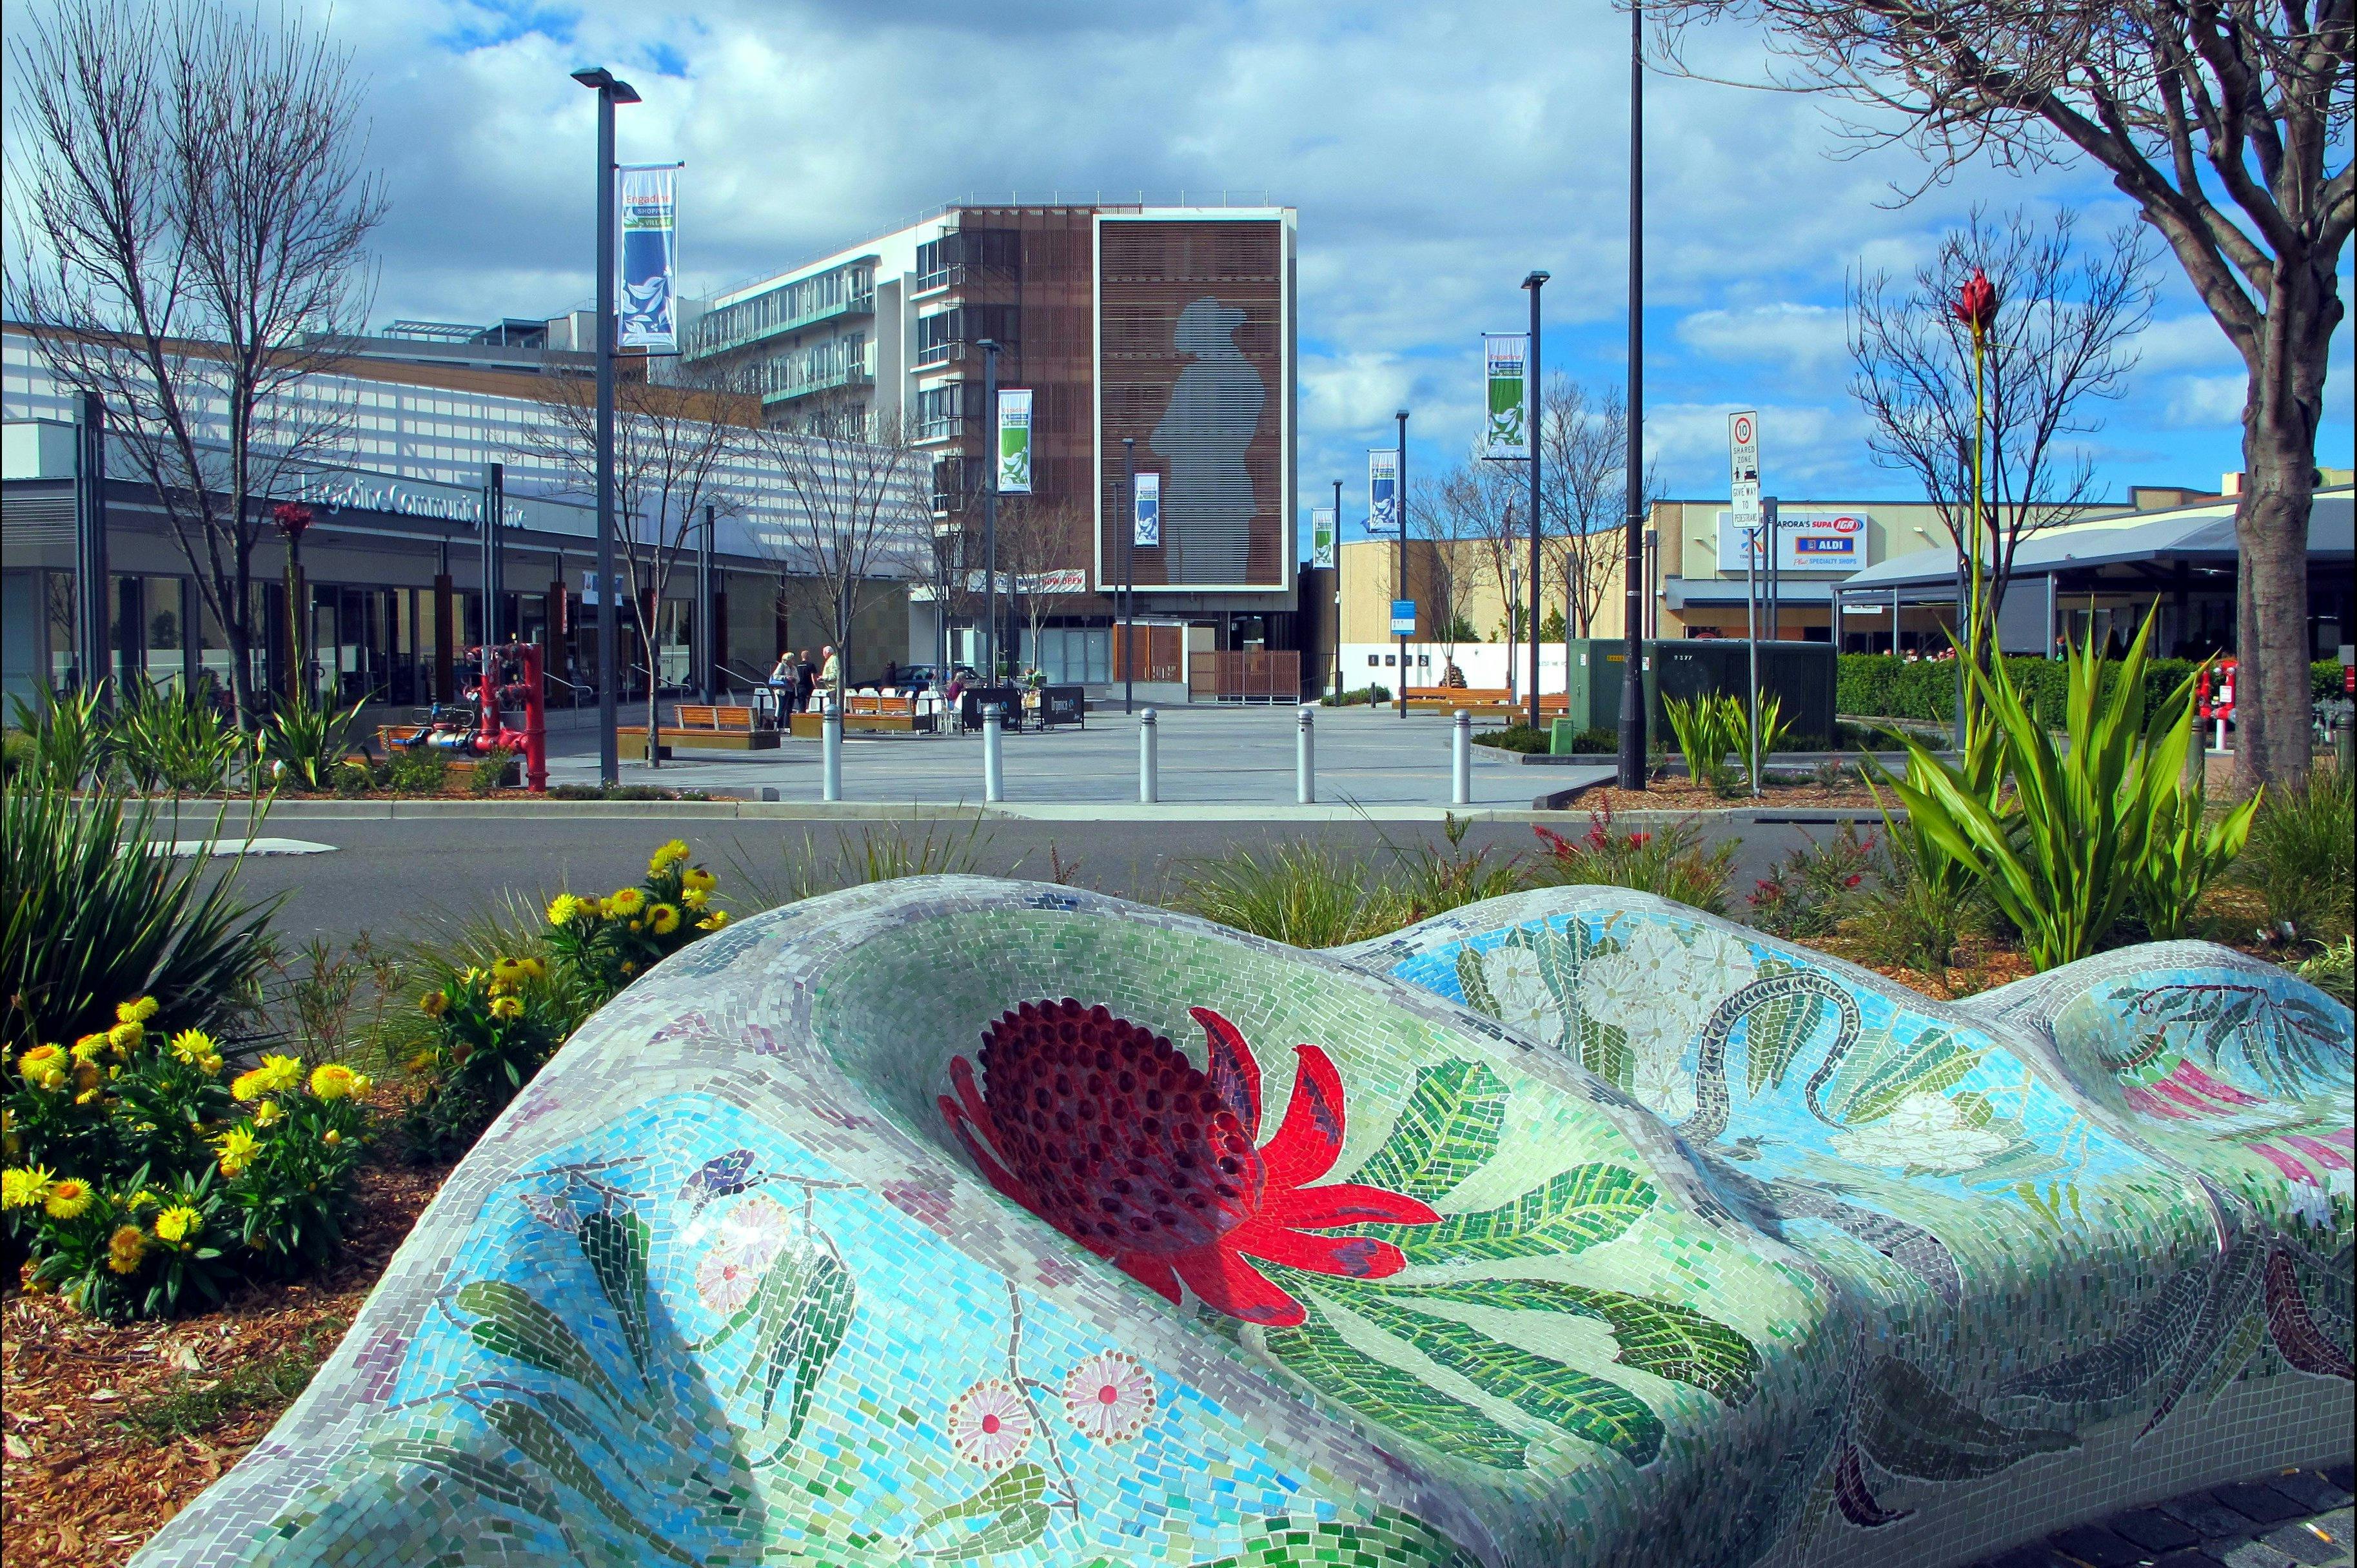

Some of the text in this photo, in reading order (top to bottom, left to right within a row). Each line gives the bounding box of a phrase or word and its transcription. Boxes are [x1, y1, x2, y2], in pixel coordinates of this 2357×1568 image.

[1739, 425, 1748, 436] 10
[1733, 446, 1755, 455] SHARED
[1737, 455, 1752, 464] ZONE
[1733, 487, 1757, 496] GIVE WAY
[1742, 500, 1749, 509] TO
[1835, 520, 1855, 529] IGA
[1818, 540, 1844, 550] ALDI
[1062, 576, 1082, 585] OPEN
